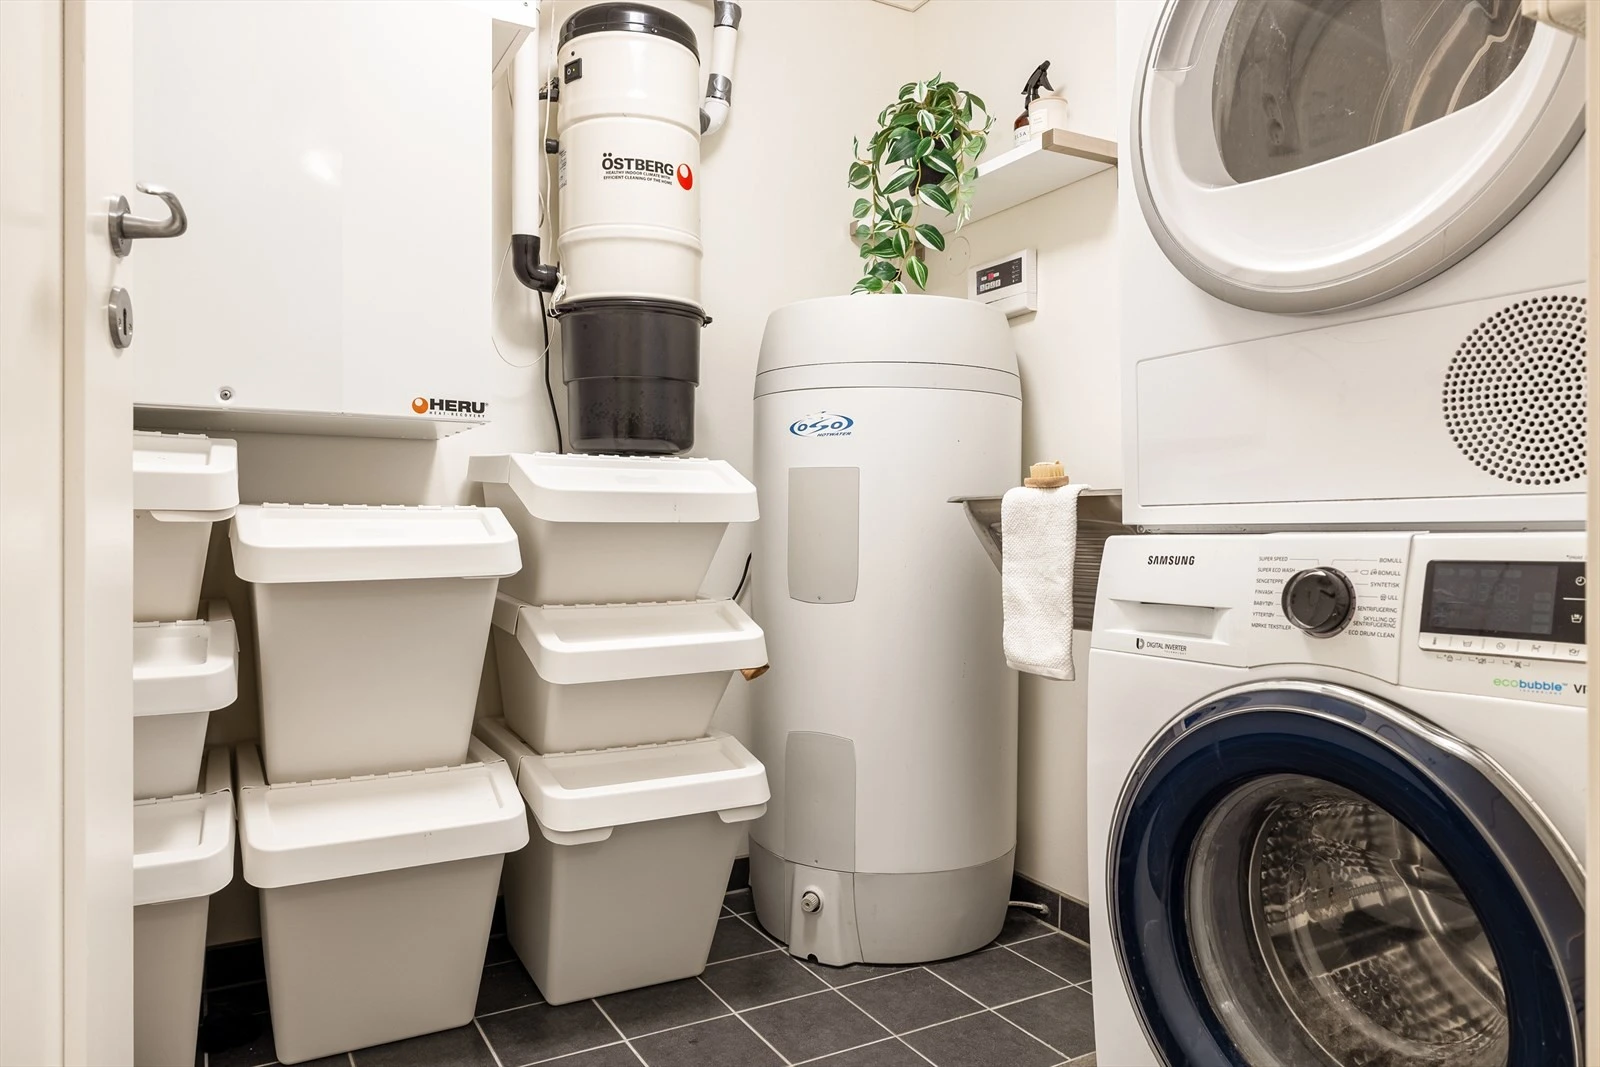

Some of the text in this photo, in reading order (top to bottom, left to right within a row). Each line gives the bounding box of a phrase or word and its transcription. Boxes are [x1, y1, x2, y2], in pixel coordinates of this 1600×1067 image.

[602, 152, 674, 176] ÖSTBERG
[429, 398, 485, 414] HERU
[1147, 555, 1196, 566] SAMSUNG
[1352, 620, 1396, 628] SENTRIFUGERING
[1146, 641, 1187, 652] DIGITAL INVERTER
[1493, 678, 1562, 692] ecobubble
